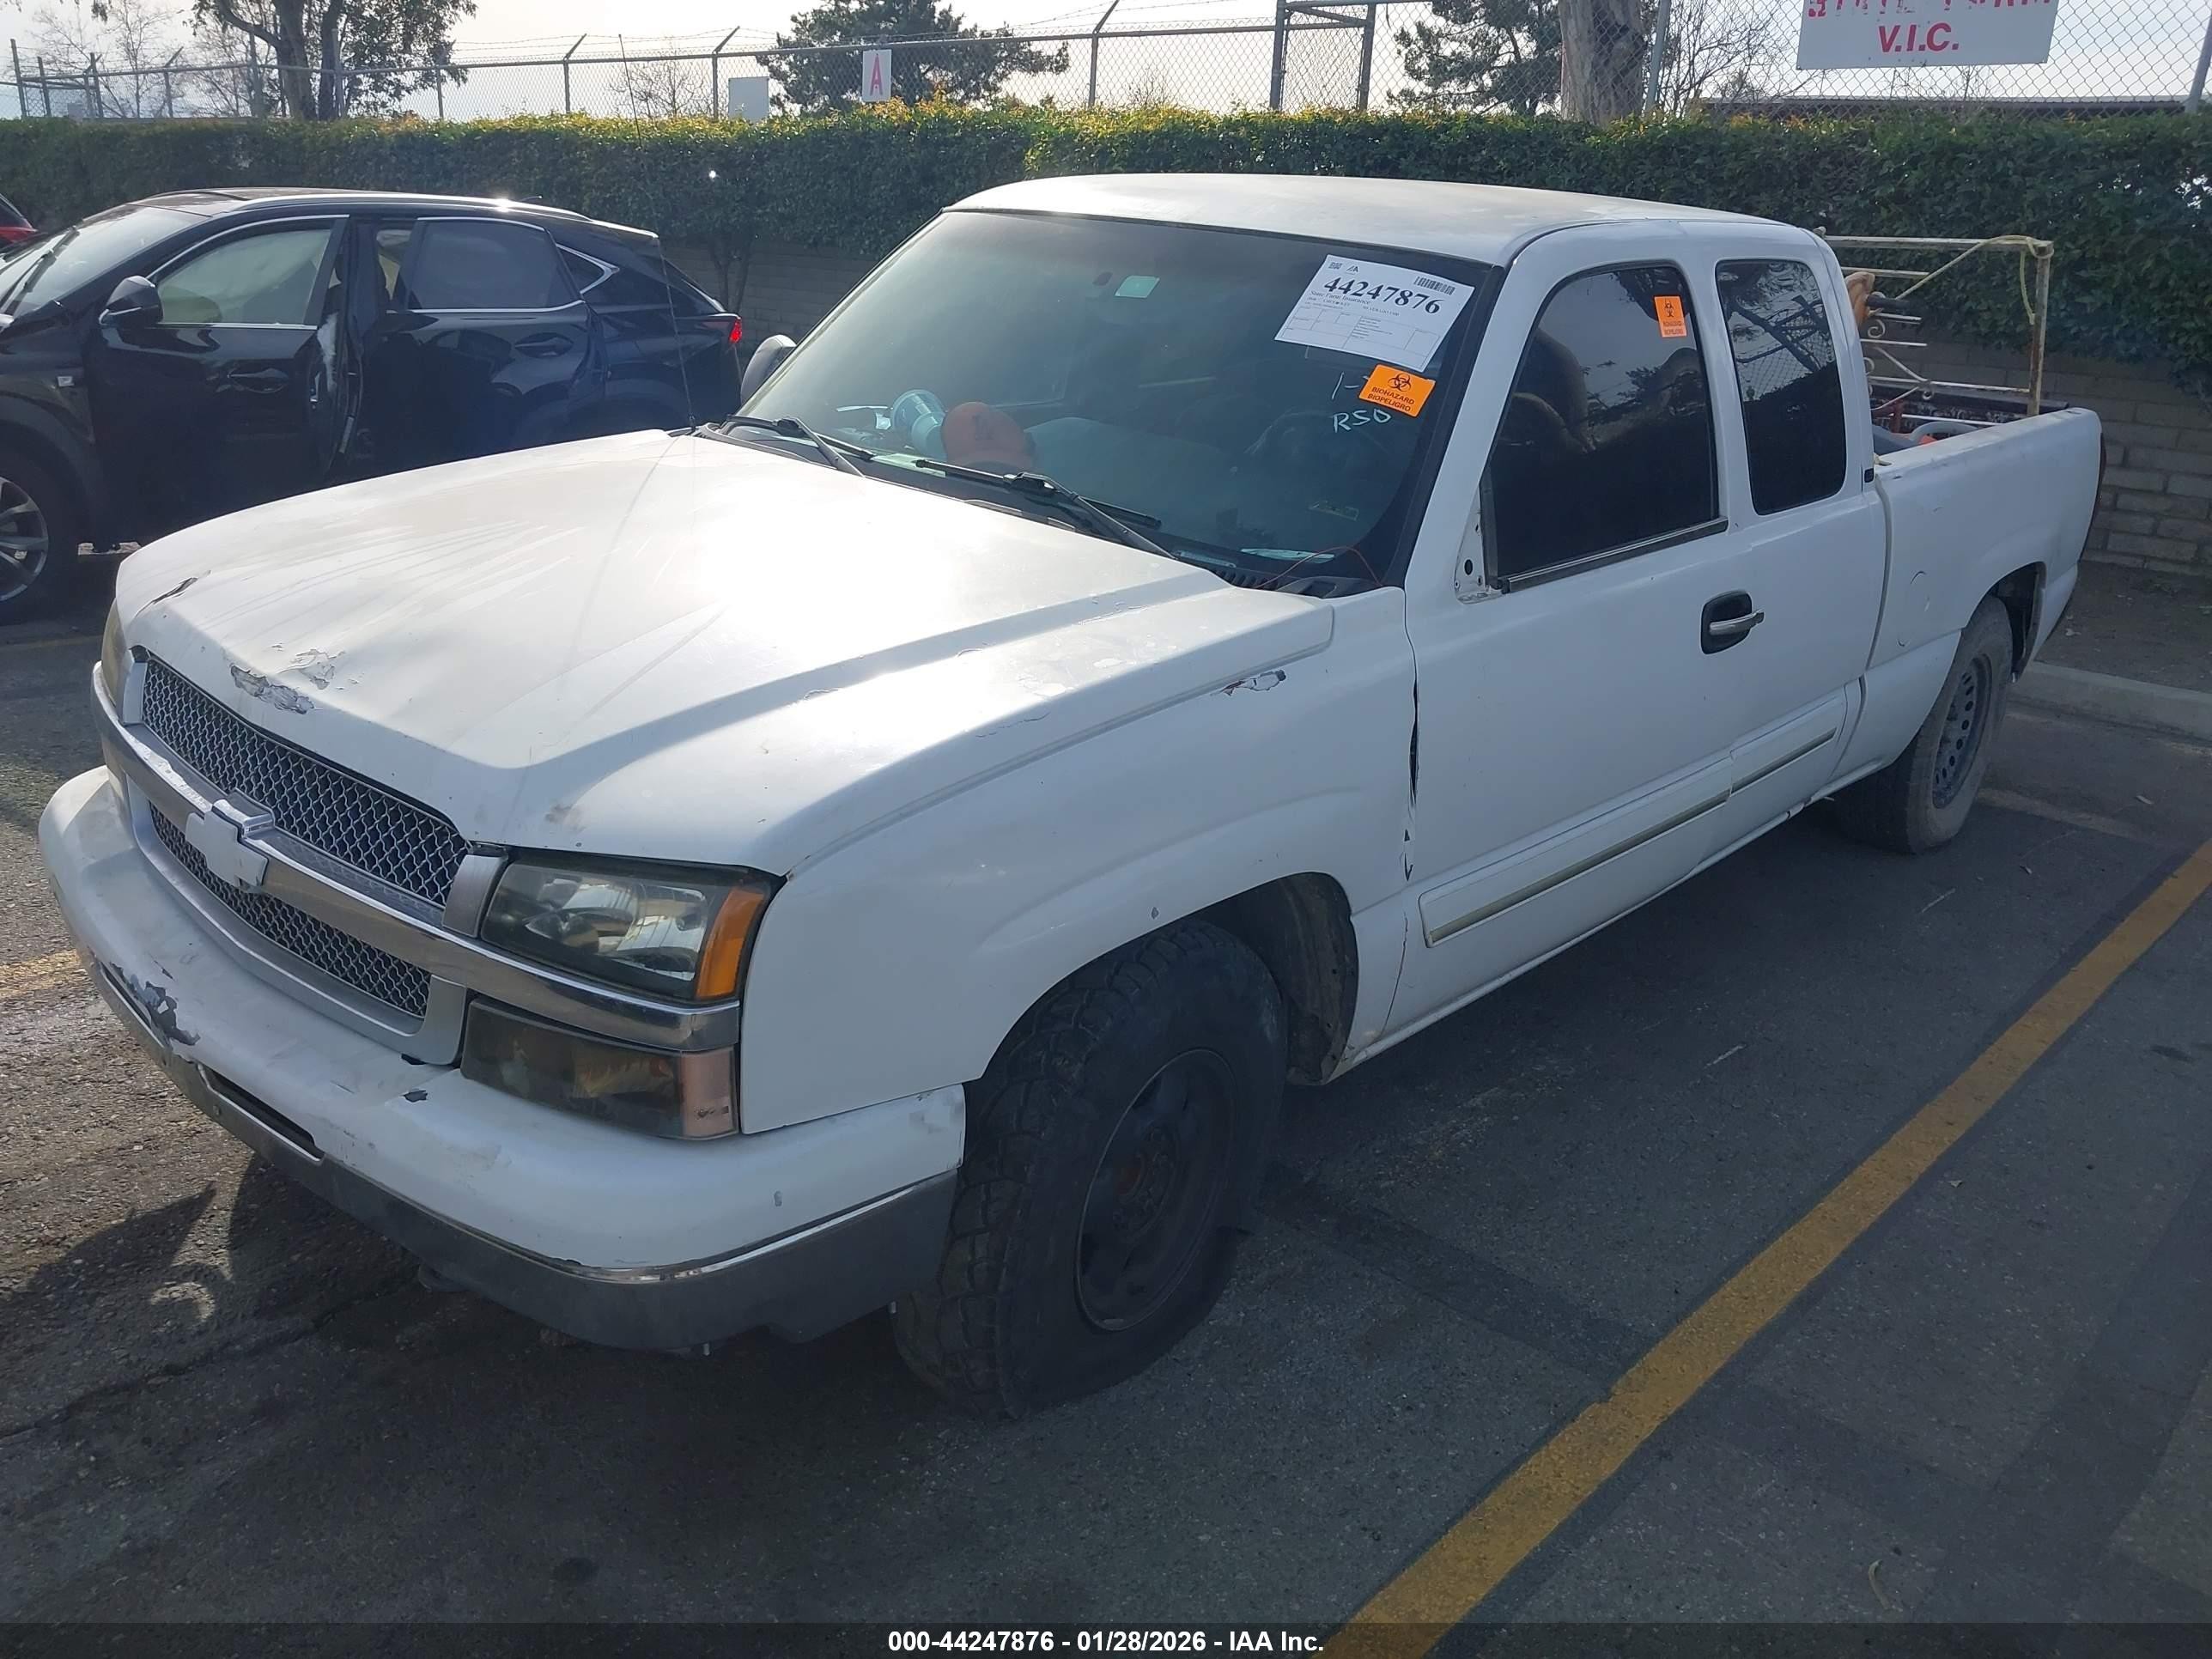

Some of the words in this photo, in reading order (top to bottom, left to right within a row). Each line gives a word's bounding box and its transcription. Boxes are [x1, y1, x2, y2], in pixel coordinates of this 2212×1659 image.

[1878, 22, 1960, 52] V.I.C.
[870, 52, 884, 96] A
[1323, 276, 1445, 313] 44247876
[1342, 295, 1371, 305] Insurance
[1367, 393, 1411, 412] BIOPELIGRO
[1371, 386, 1414, 404] BIOHAZARD
